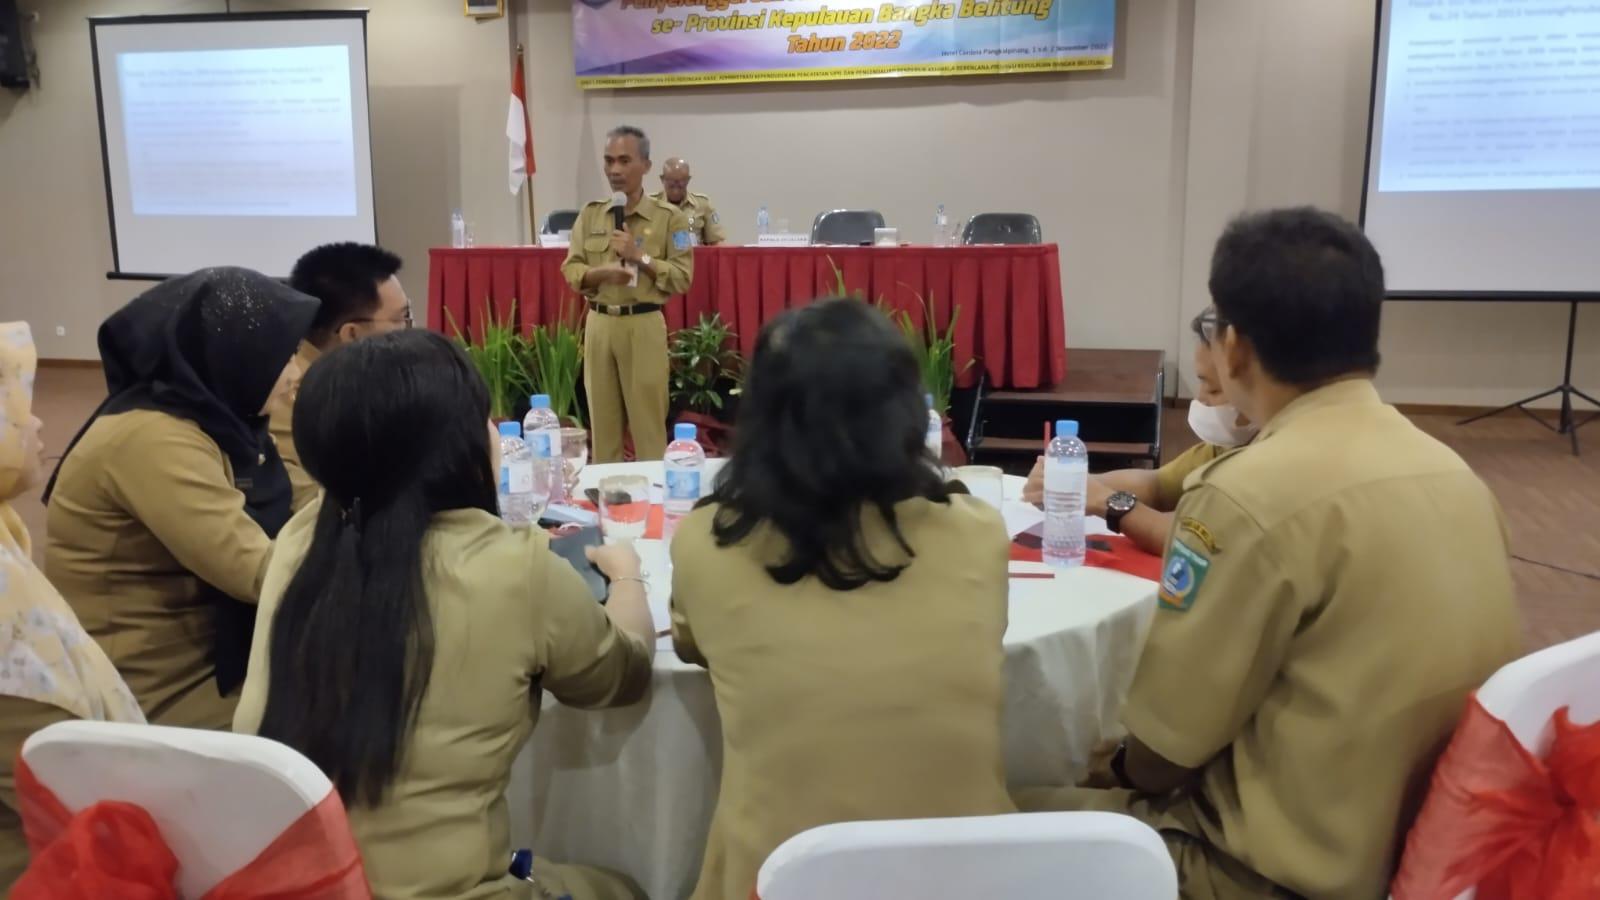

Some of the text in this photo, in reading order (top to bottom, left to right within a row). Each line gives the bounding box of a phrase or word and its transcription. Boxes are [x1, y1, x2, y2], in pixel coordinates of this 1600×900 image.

[651, 0, 1052, 33] se- Provinsi Kepulauan Bangka Belitung
[787, 30, 902, 54] Tahun 2022
